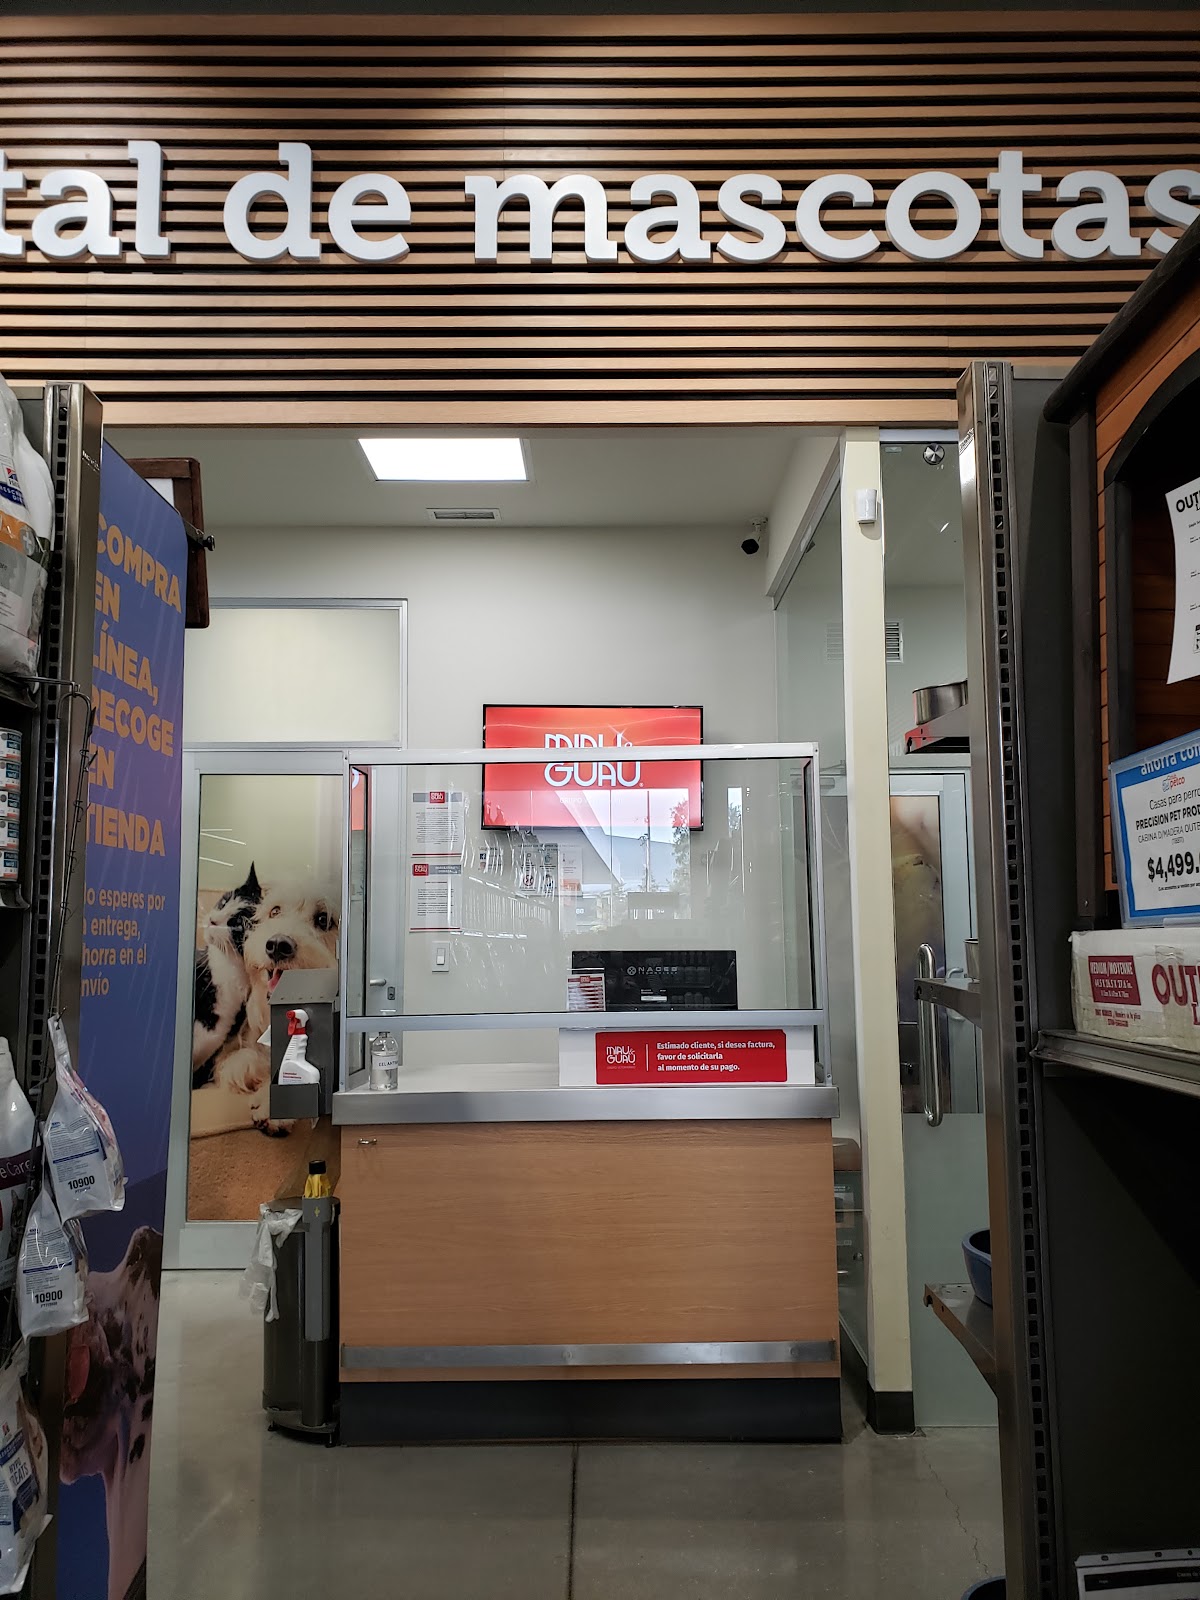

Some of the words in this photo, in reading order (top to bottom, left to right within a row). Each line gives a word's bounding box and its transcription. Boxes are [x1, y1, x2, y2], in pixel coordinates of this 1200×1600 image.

[223, 141, 412, 262] de
[464, 150, 1200, 263] mascotas
[1176, 490, 1200, 513] OUT
[544, 761, 641, 787] GUAU
[1149, 797, 1167, 811] Casas
[1168, 793, 1182, 808] para
[1135, 812, 1169, 831] PRECISION
[1169, 809, 1181, 822] PET
[1138, 832, 1158, 844] CABINA
[1147, 851, 1200, 883] $4,499.
[99, 888, 145, 911] esperes
[147, 894, 166, 915] por
[91, 914, 141, 941] entrega,
[119, 947, 134, 965] en
[137, 943, 147, 966] el
[1152, 963, 1200, 1007] OUT
[657, 1041, 689, 1050] Estimado
[690, 1041, 717, 1050] cliente,
[717, 1041, 724, 1049] si
[725, 1041, 747, 1049] desea
[747, 1040, 776, 1049] factura,
[687, 1052, 723, 1060] solicitarla
[719, 1064, 741, 1072] pago.
[67, 1175, 96, 1190] 10900
[34, 1289, 63, 1304] 10900
